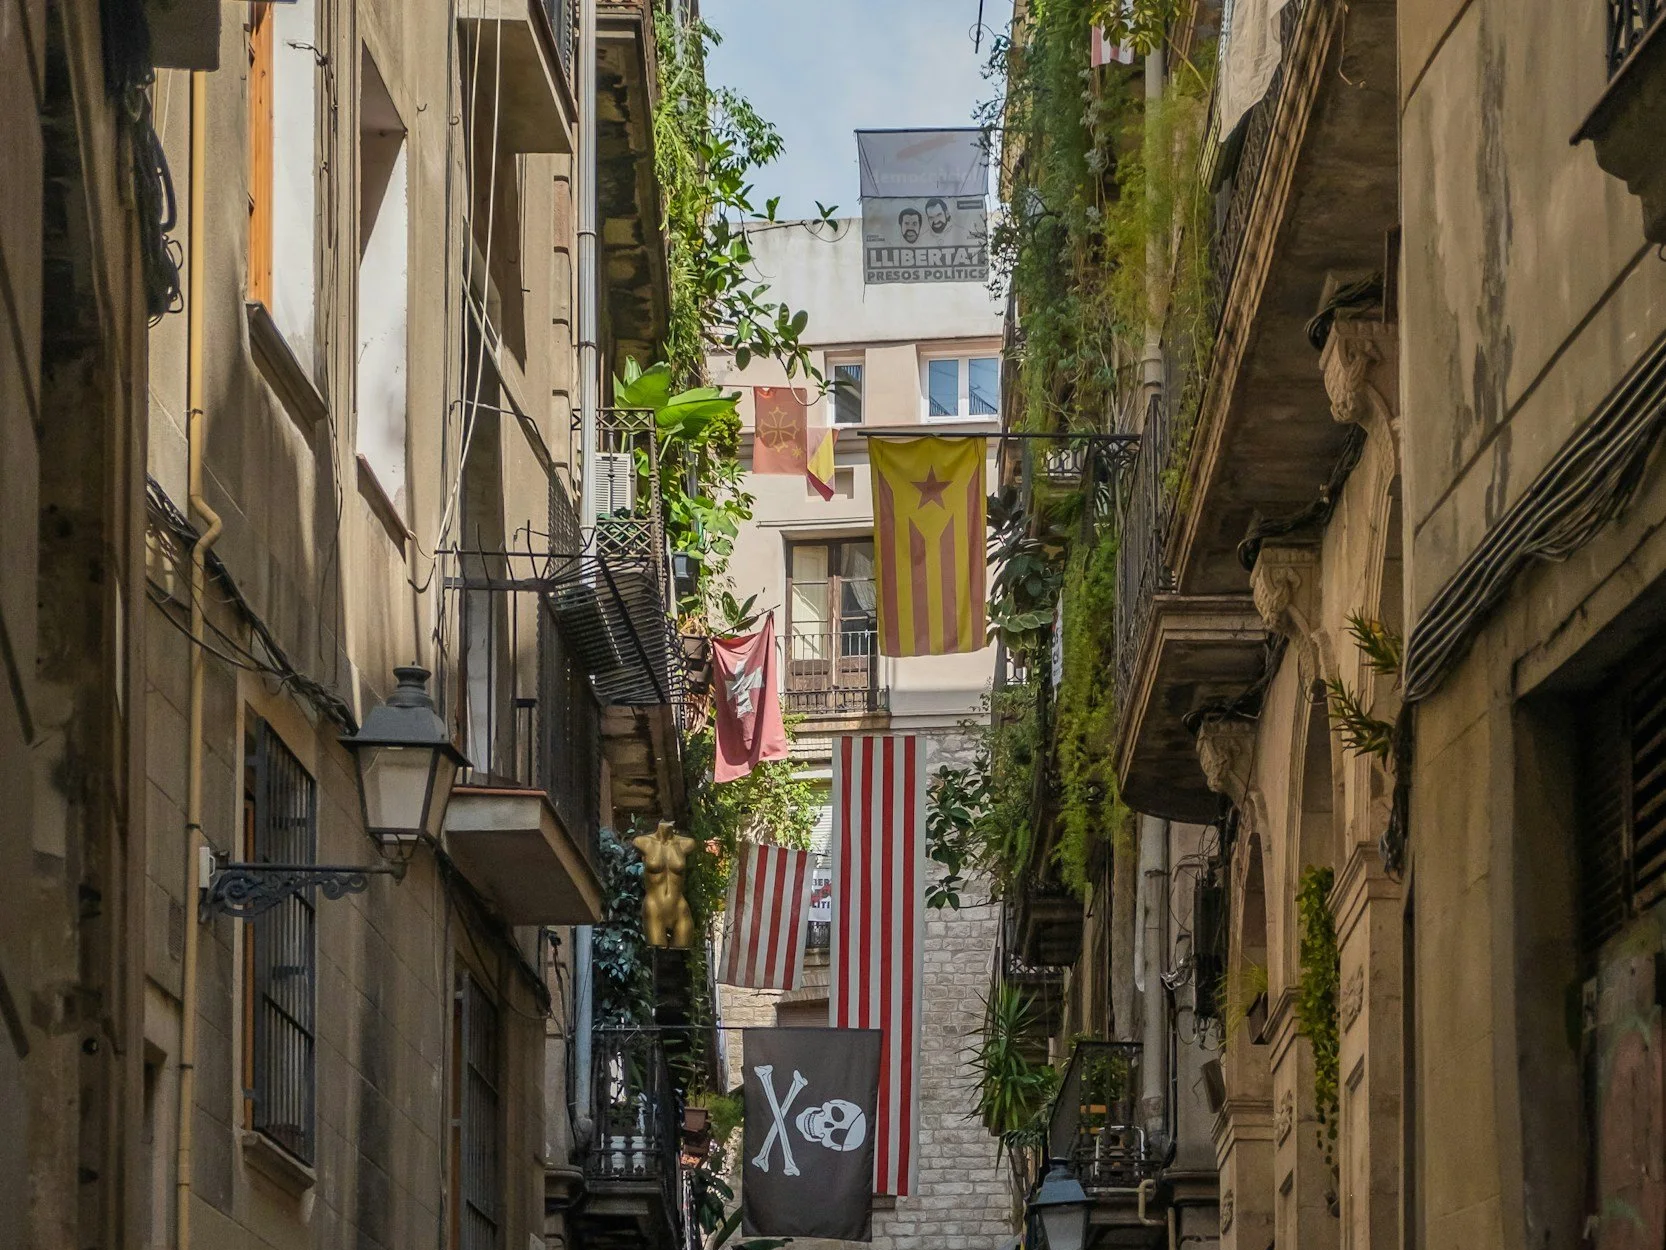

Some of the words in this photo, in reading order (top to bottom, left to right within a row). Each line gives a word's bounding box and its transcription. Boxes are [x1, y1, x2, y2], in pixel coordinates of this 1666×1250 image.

[870, 248, 980, 268] LLIBERTAT
[867, 270, 920, 281] PRESOS
[924, 266, 987, 280] POLÍTICS
